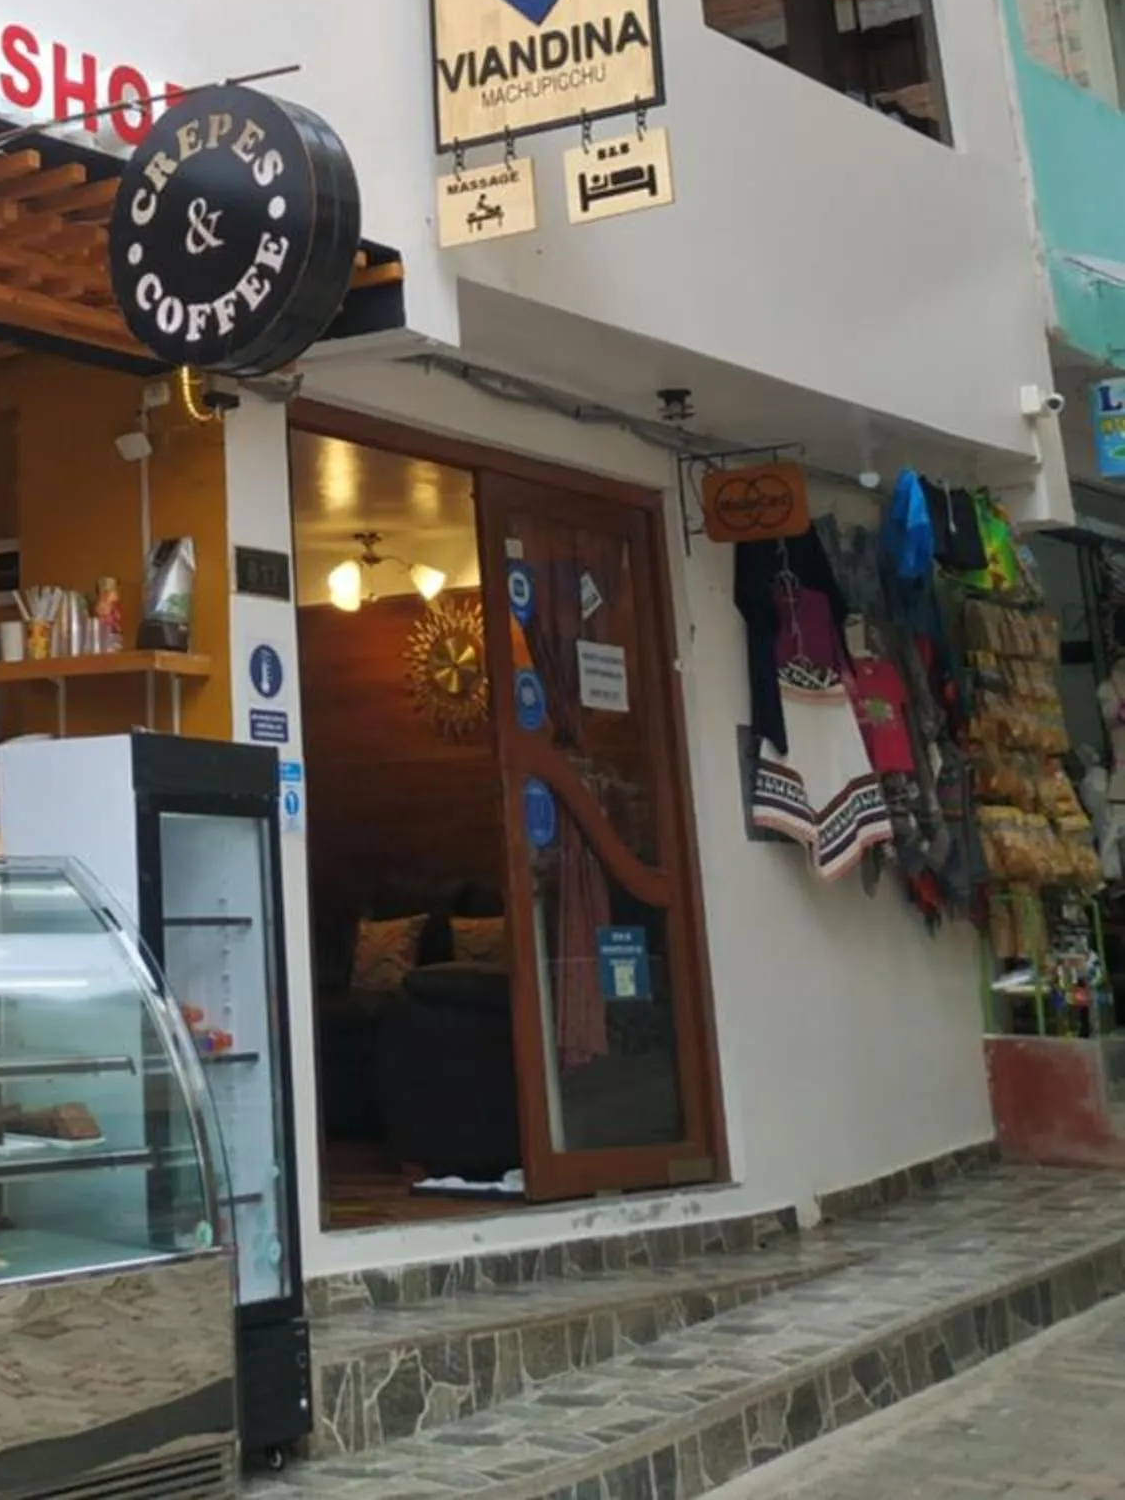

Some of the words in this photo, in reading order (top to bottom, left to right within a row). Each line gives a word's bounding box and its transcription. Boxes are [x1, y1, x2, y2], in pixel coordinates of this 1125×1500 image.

[437, 11, 648, 93] VIANDINA
[481, 64, 606, 108] MACHUPICCHU
[131, 112, 284, 225] CREPES
[446, 170, 520, 196] MASSAGE
[185, 197, 224, 254] &
[135, 232, 290, 342] COFFEE
